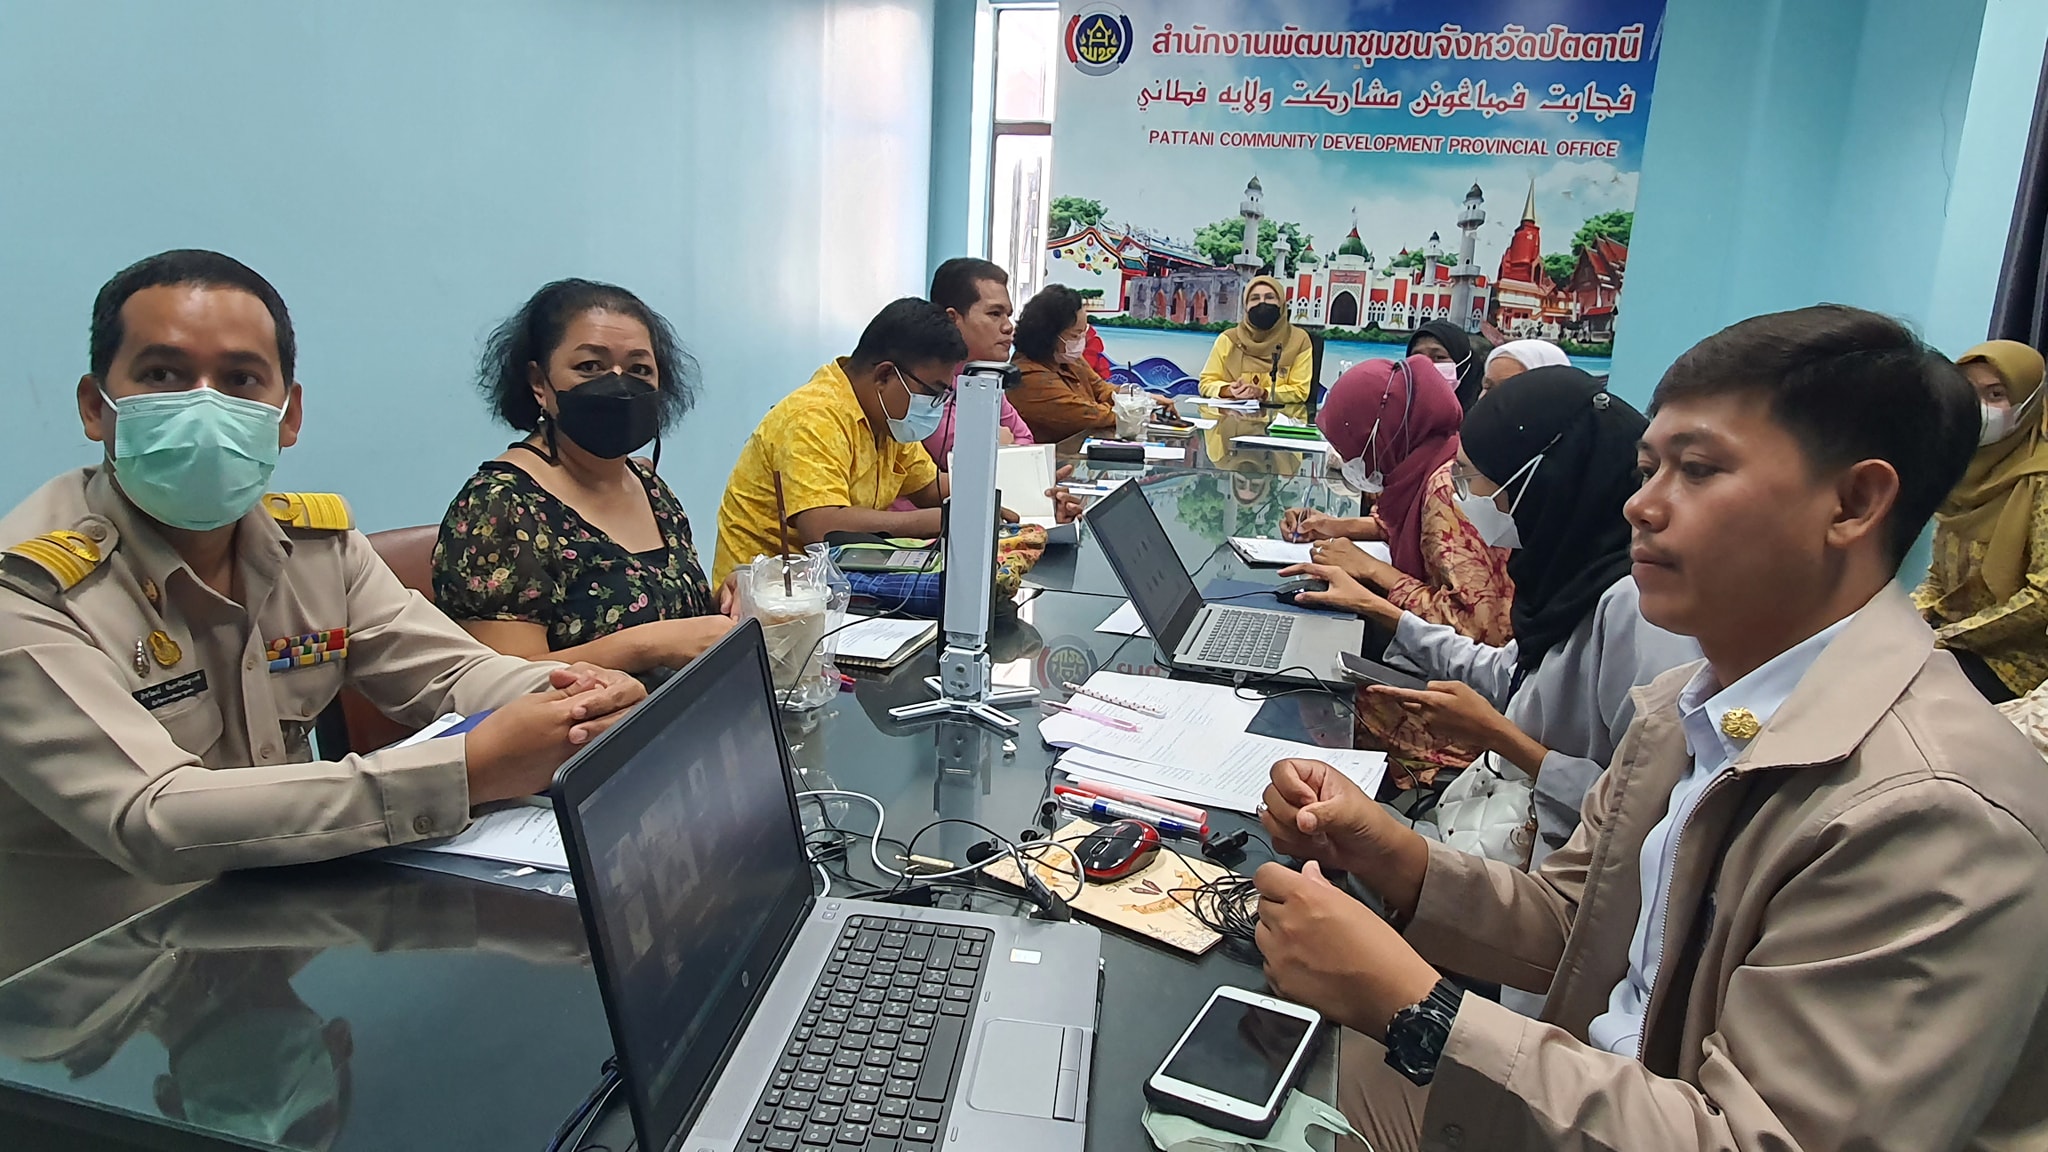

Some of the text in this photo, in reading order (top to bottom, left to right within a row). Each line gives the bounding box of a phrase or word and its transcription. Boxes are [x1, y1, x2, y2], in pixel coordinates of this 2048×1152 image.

[1152, 23, 1642, 65] สำนักงานพัฒนาชุมชนจังหวัดปัตตานี
[1149, 130, 1618, 157] PATTANI COMMUNITY DEVELOPMENT PROVINCIAL OFFICE
